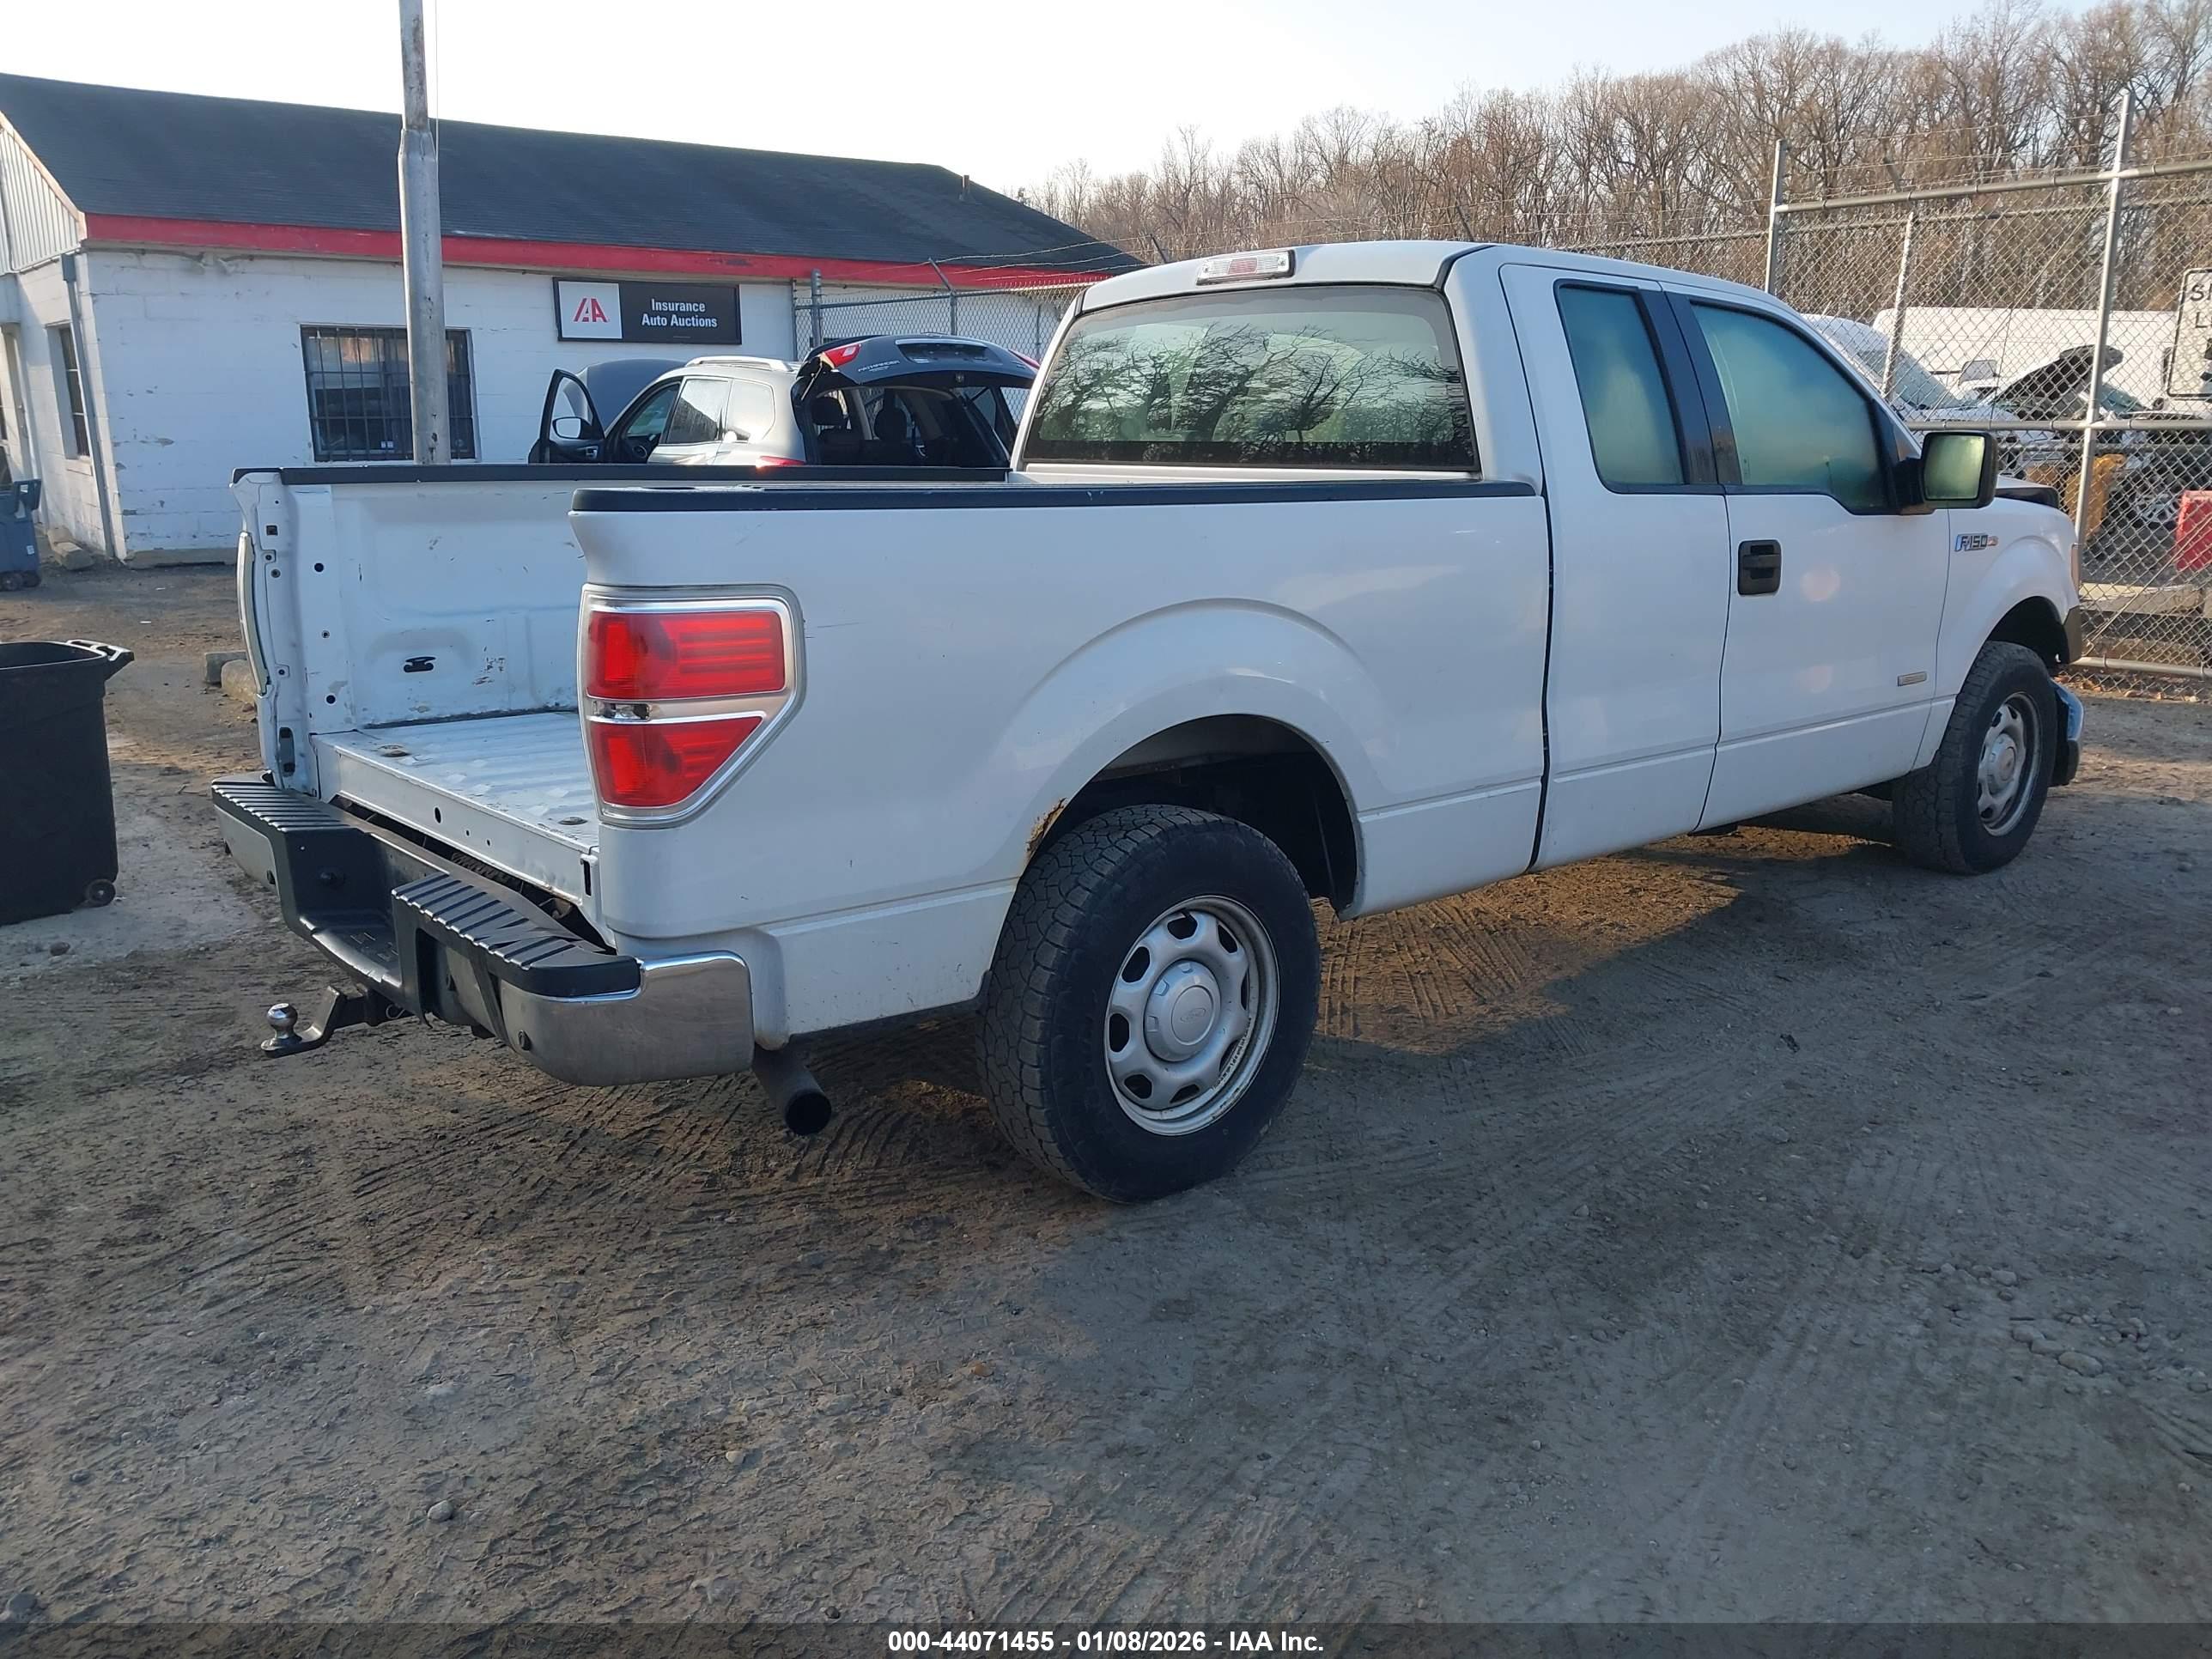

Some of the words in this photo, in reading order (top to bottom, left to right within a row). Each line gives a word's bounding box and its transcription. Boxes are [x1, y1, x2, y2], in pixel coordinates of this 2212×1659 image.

[651, 299, 706, 313] Insurance
[641, 314, 667, 327] Auto
[671, 314, 718, 328] Auctions
